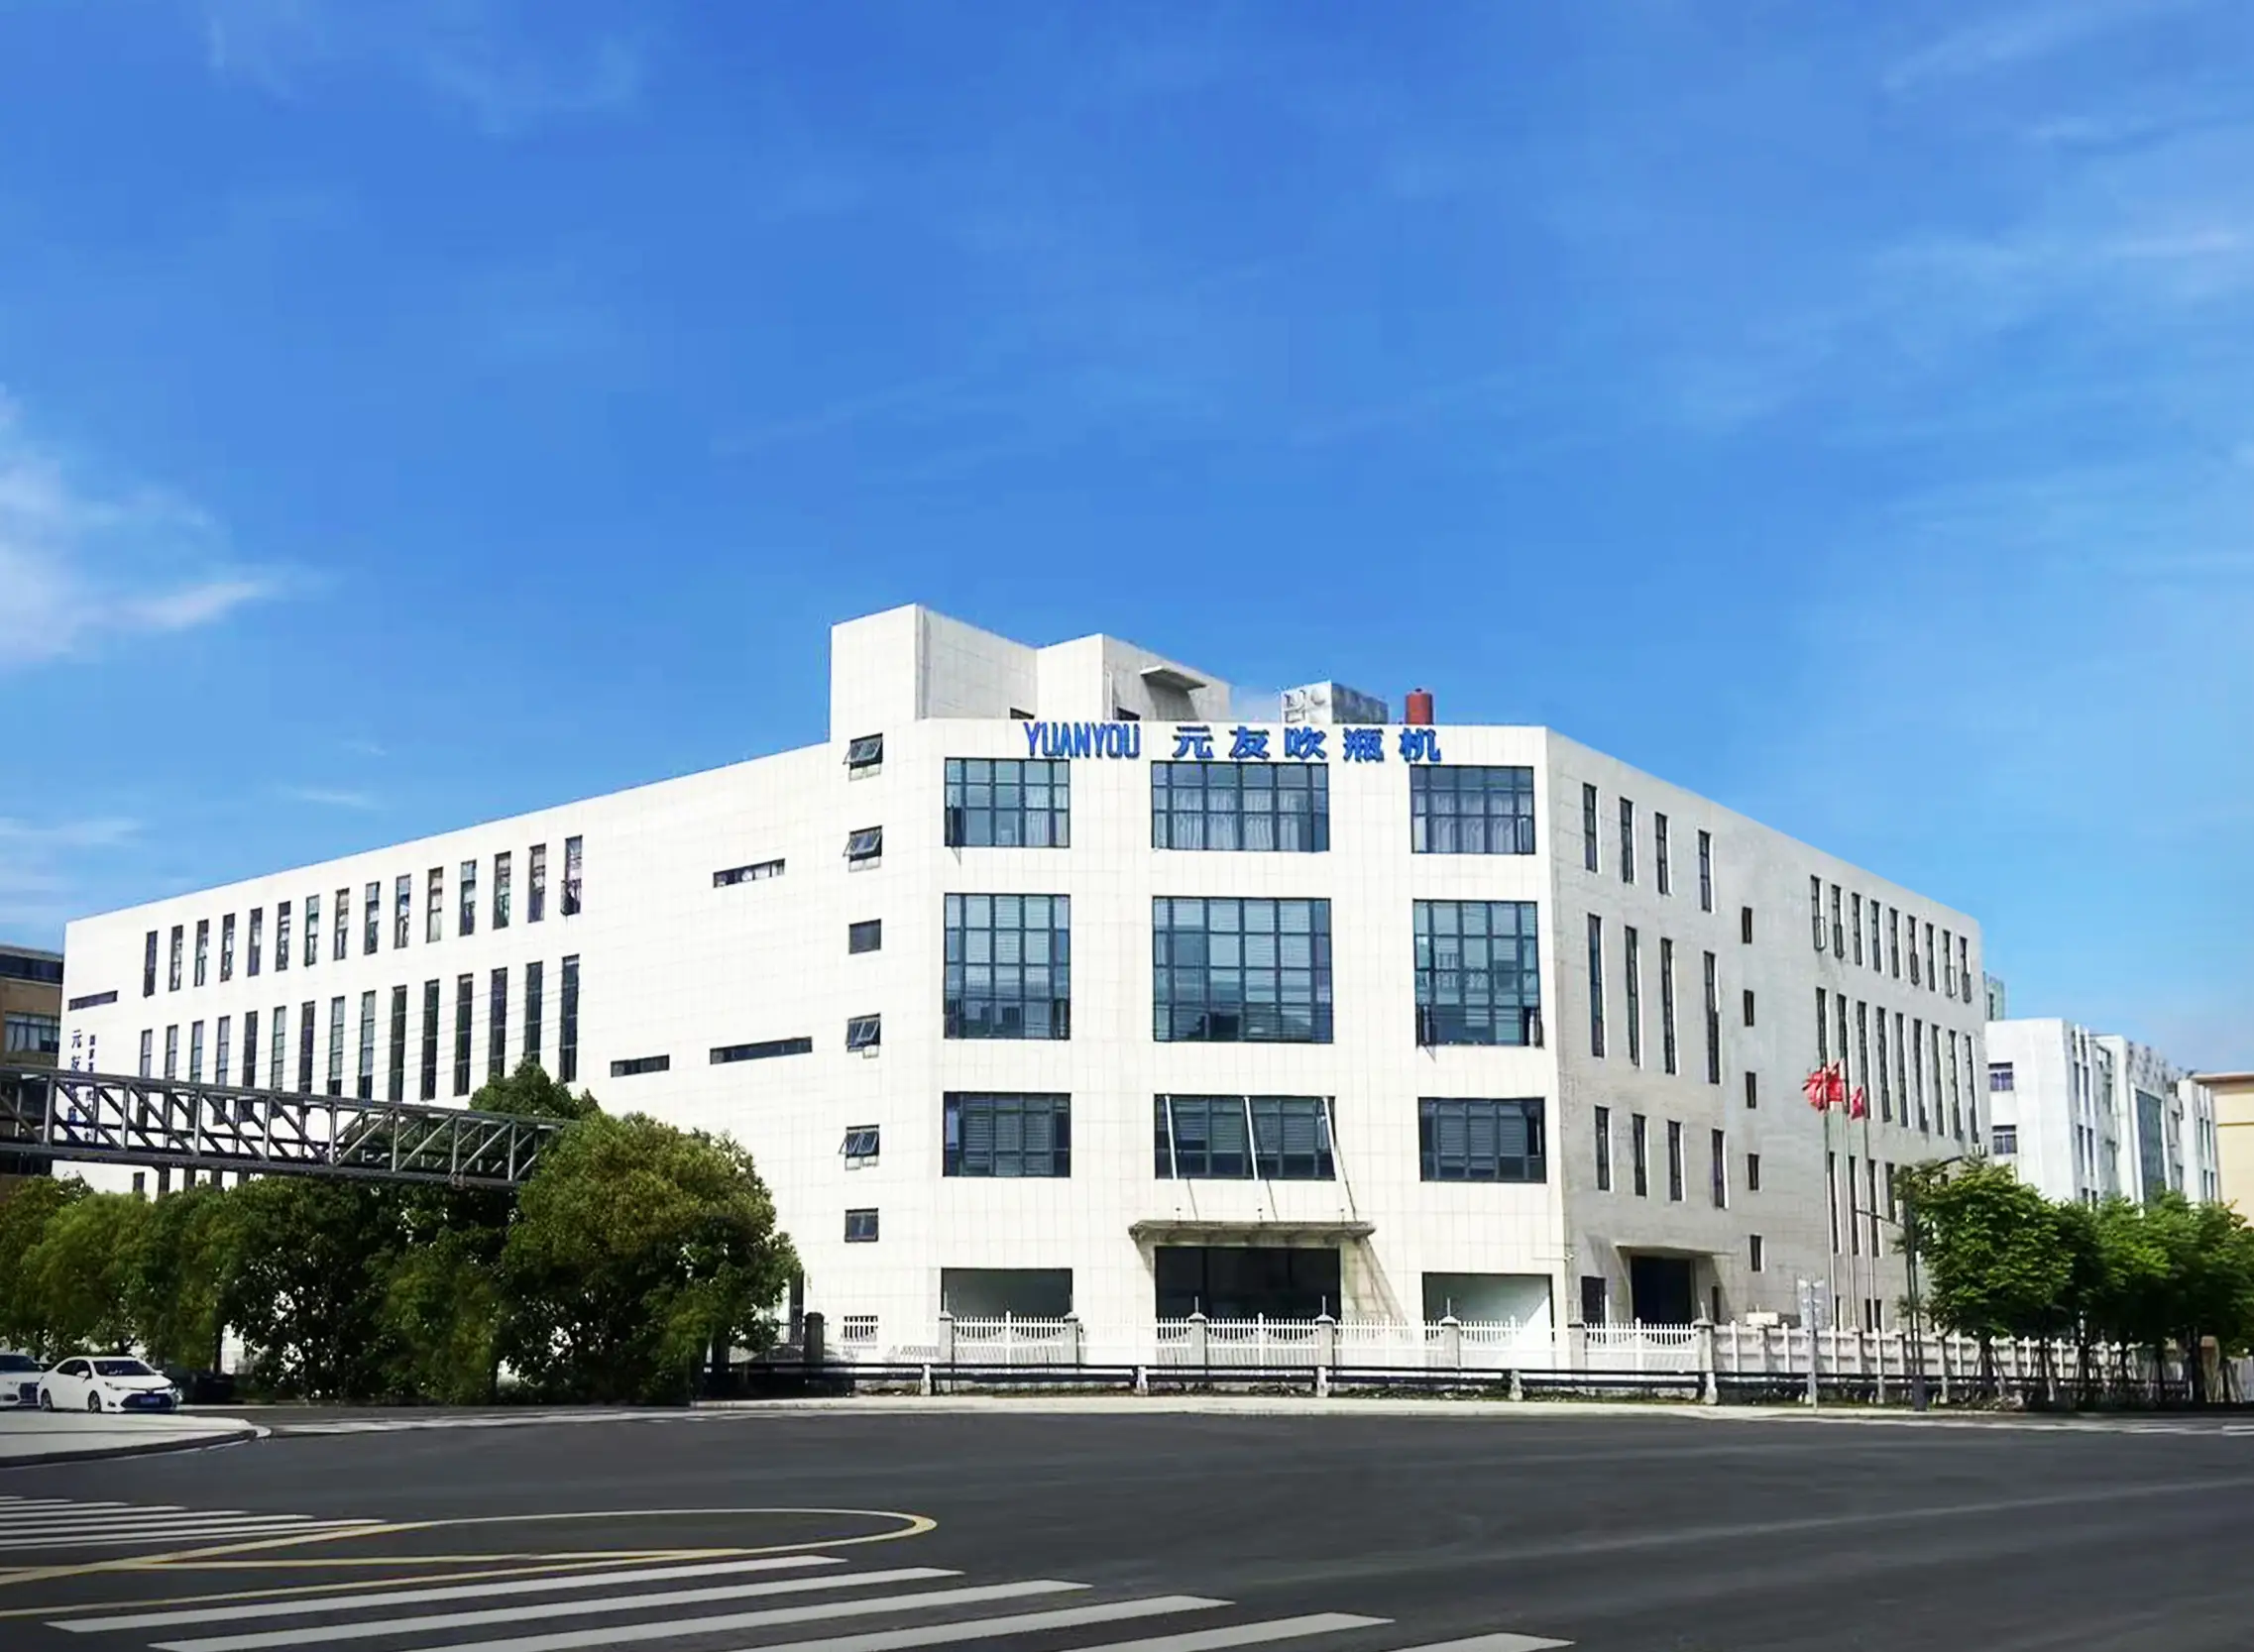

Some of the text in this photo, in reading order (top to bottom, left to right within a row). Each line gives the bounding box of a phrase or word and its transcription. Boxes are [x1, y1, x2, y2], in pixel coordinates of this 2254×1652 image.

[1023, 721, 1140, 759] YUANYOU
[1173, 725, 1442, 762] 元友吹瓶机
